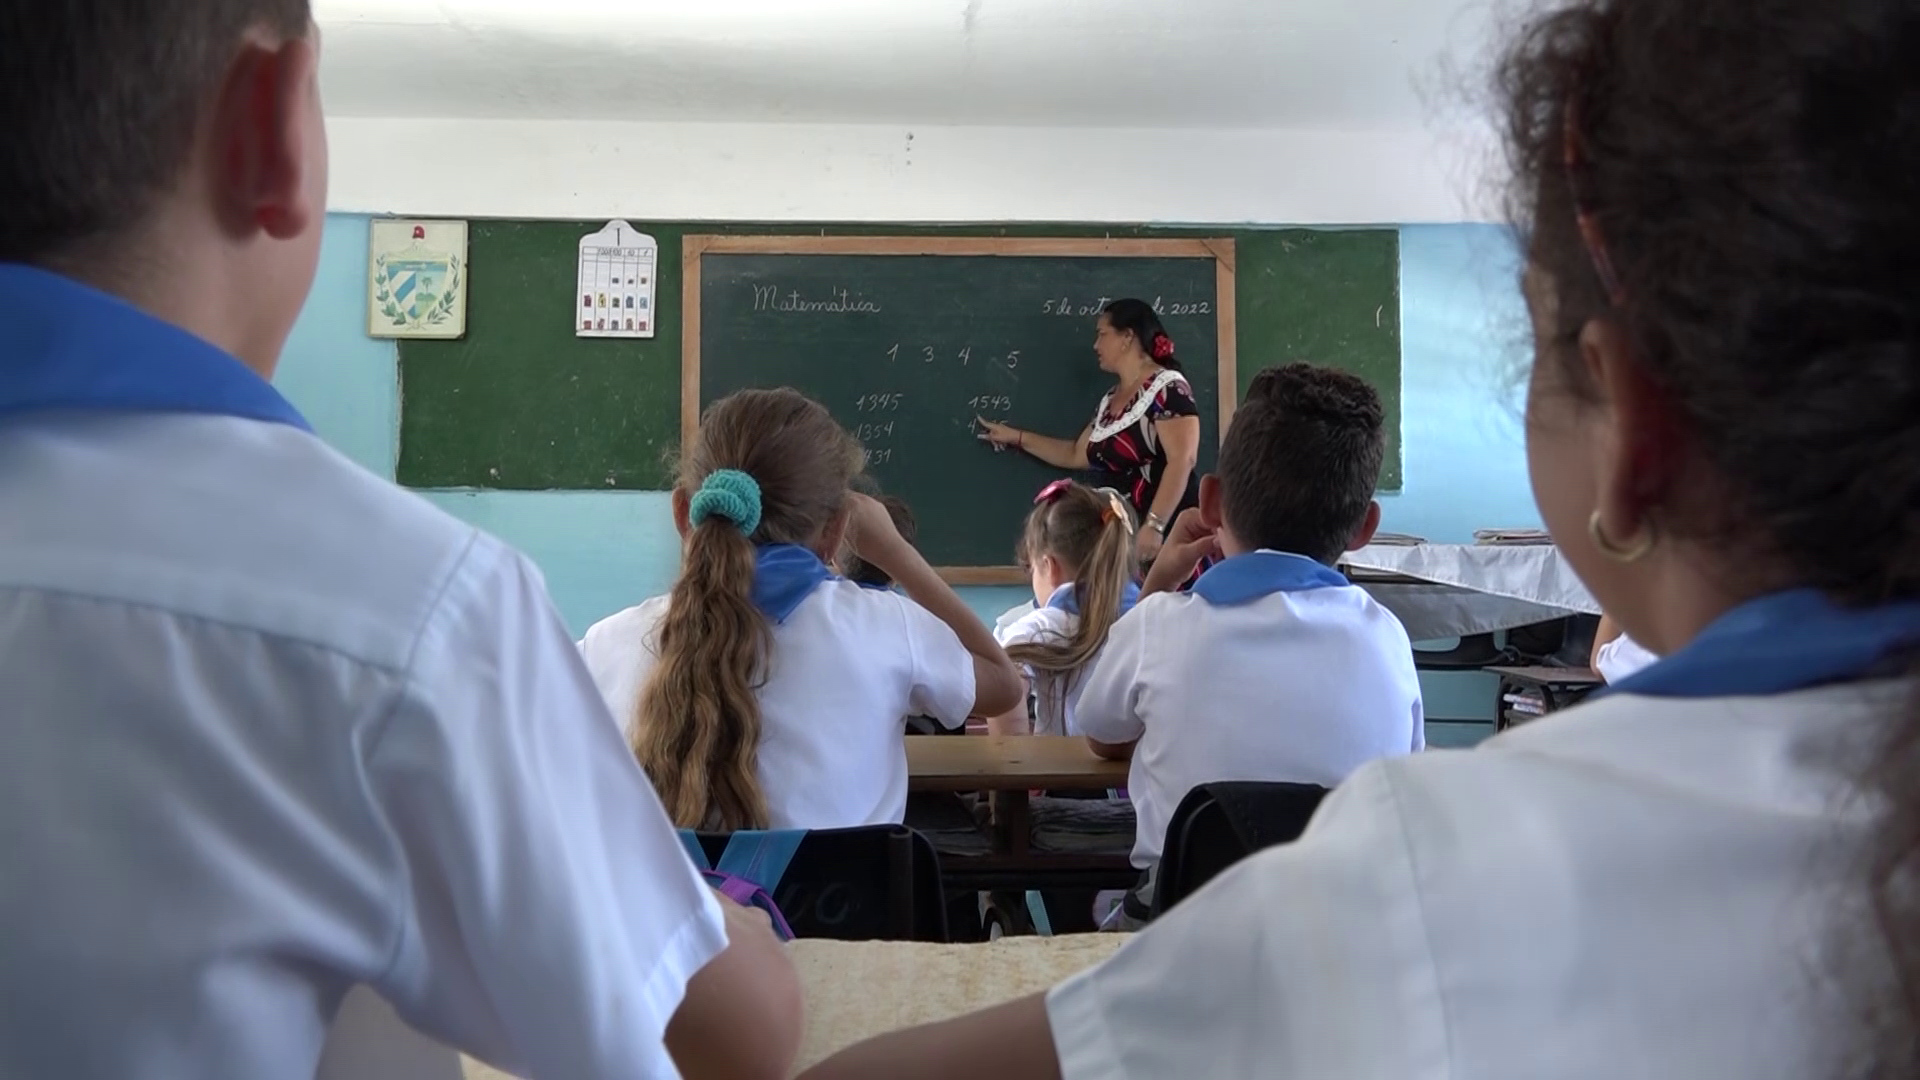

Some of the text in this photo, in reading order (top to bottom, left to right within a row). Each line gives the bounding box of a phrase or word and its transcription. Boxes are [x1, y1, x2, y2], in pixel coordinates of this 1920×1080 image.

[753, 283, 881, 313] Matemática
[1042, 299, 1056, 314] 5
[1056, 297, 1072, 315] de
[1170, 301, 1212, 315] 2022
[887, 343, 1021, 369] 1 3 4 5
[856, 393, 904, 411] 1345
[968, 394, 1011, 411] 1543
[856, 420, 894, 441] 1354
[864, 448, 891, 465] 431
